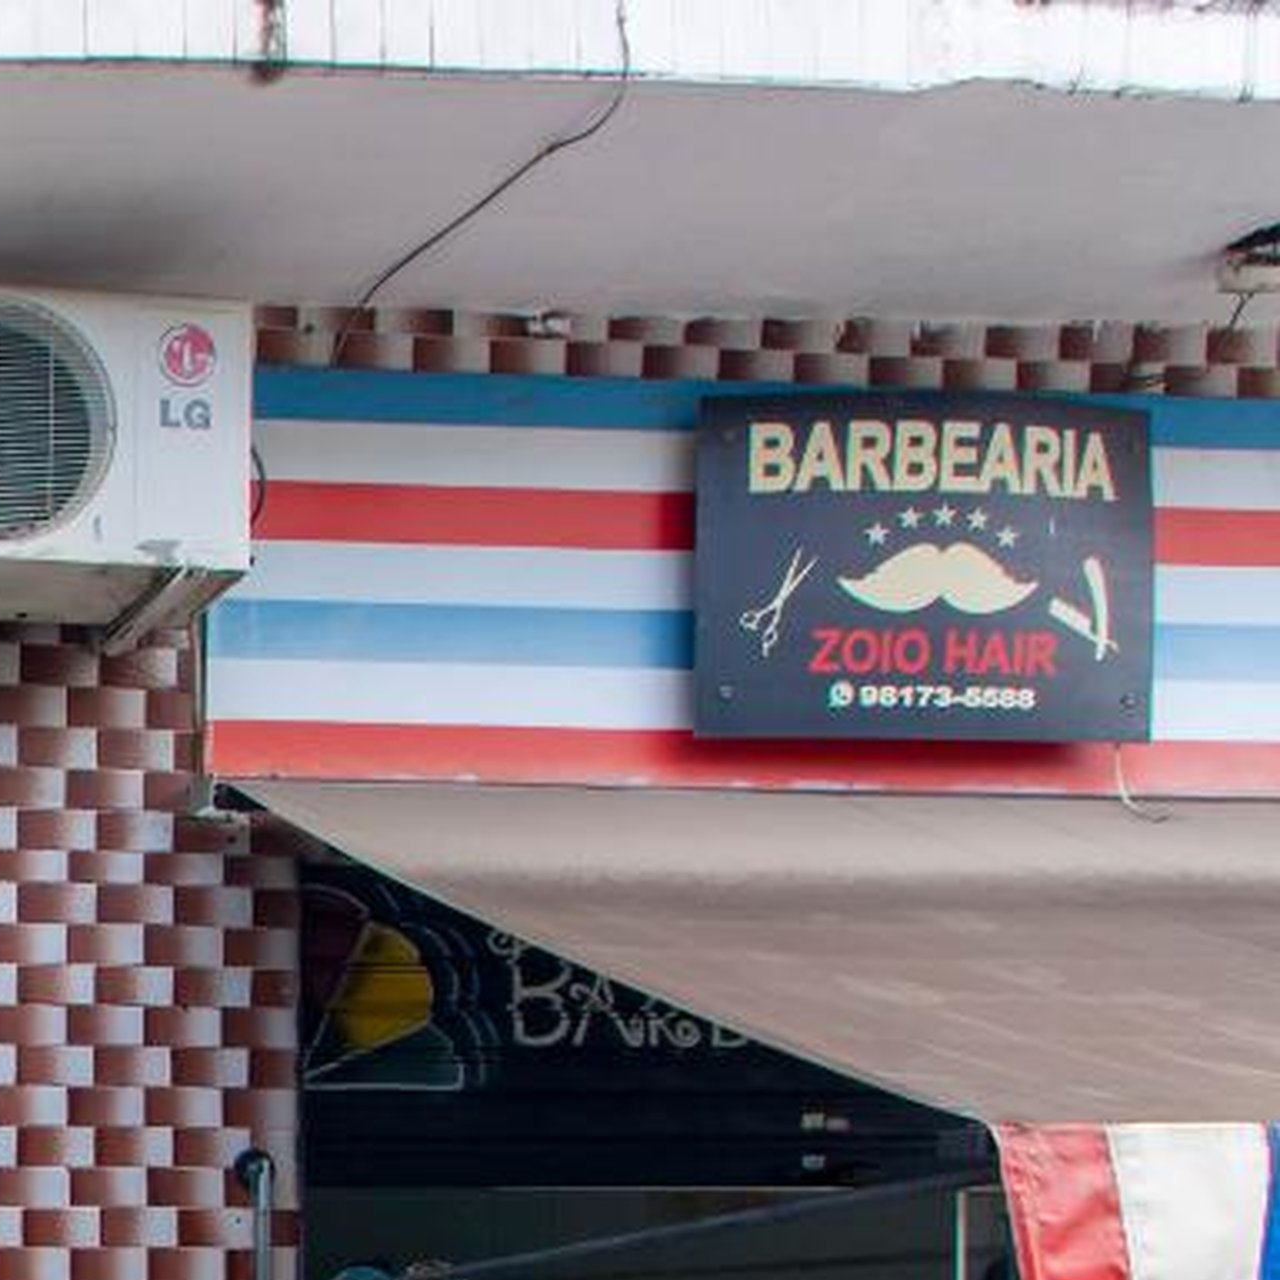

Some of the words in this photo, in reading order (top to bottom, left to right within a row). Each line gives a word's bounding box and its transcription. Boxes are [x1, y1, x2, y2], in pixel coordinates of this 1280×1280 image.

[159, 398, 212, 431] LG
[748, 420, 1117, 502] BARBEARIA
[808, 630, 932, 676] ZOIO
[943, 628, 1058, 678] HAIR
